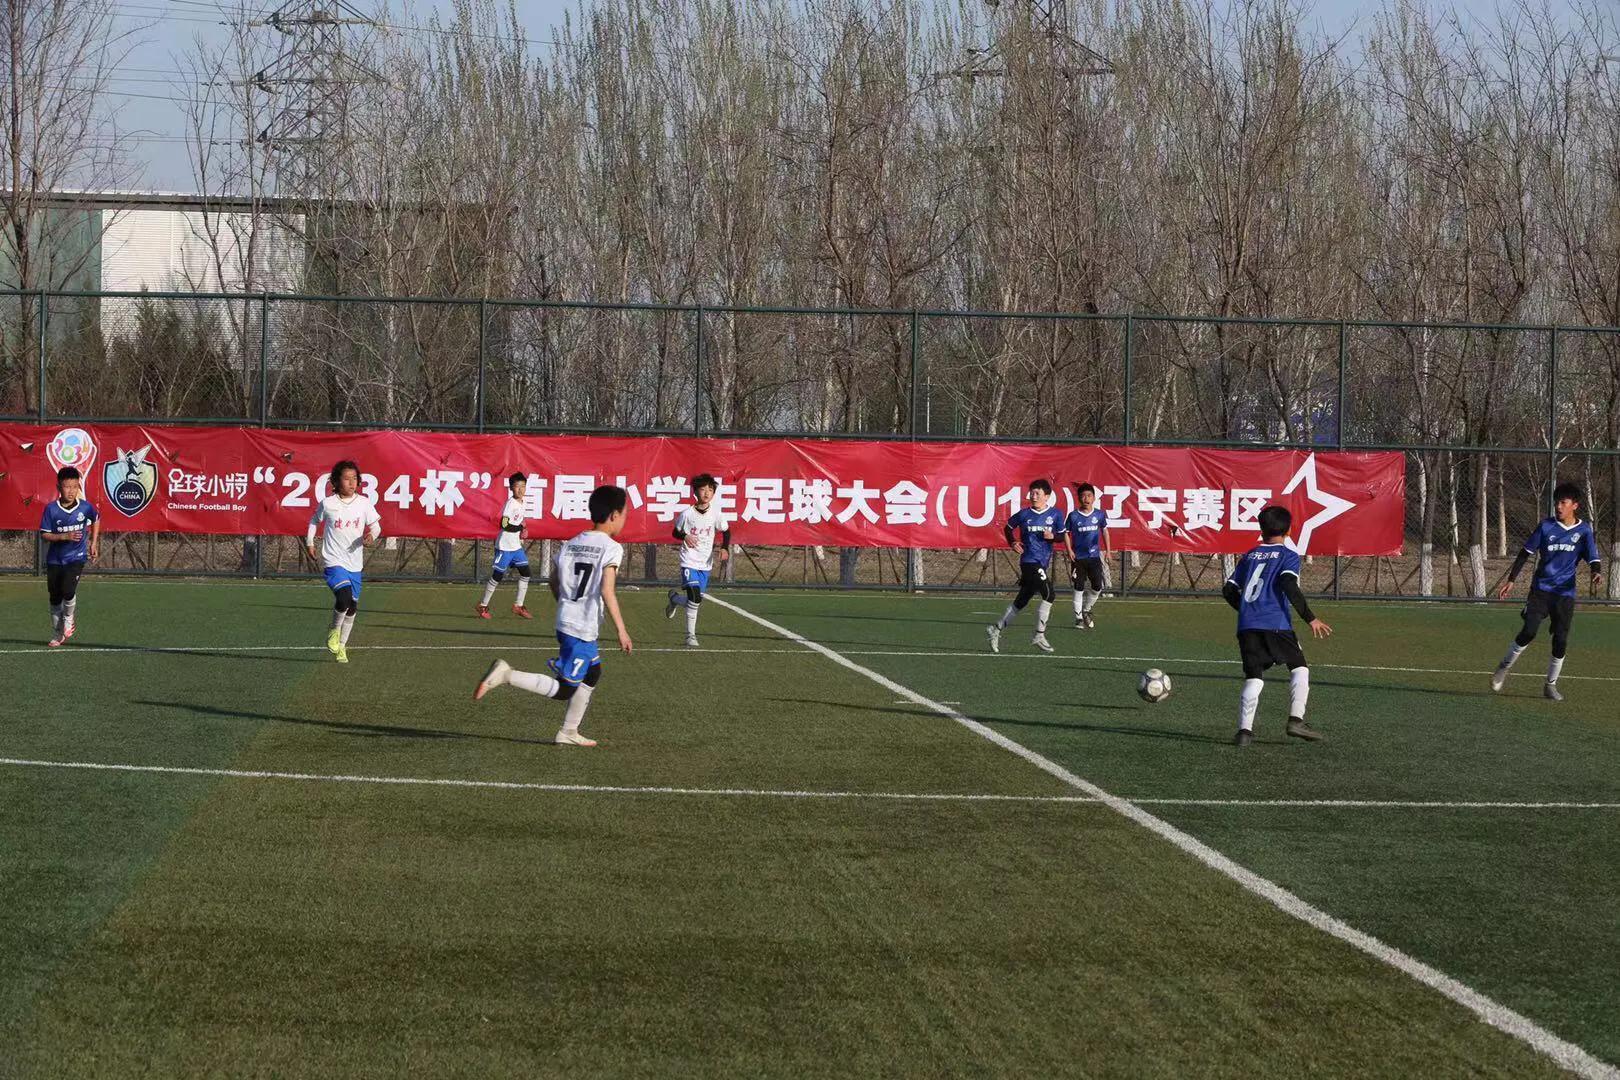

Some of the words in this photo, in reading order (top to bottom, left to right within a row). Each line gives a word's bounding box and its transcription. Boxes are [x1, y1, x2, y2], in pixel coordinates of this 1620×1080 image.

[119, 493, 141, 501] CHINA
[167, 502, 197, 511] Chinese
[199, 503, 231, 512] Football
[232, 504, 247, 513] Boy
[571, 562, 594, 602] 7
[1038, 568, 1047, 581] 3
[1244, 563, 1267, 603] 6
[571, 658, 585, 677] 7
